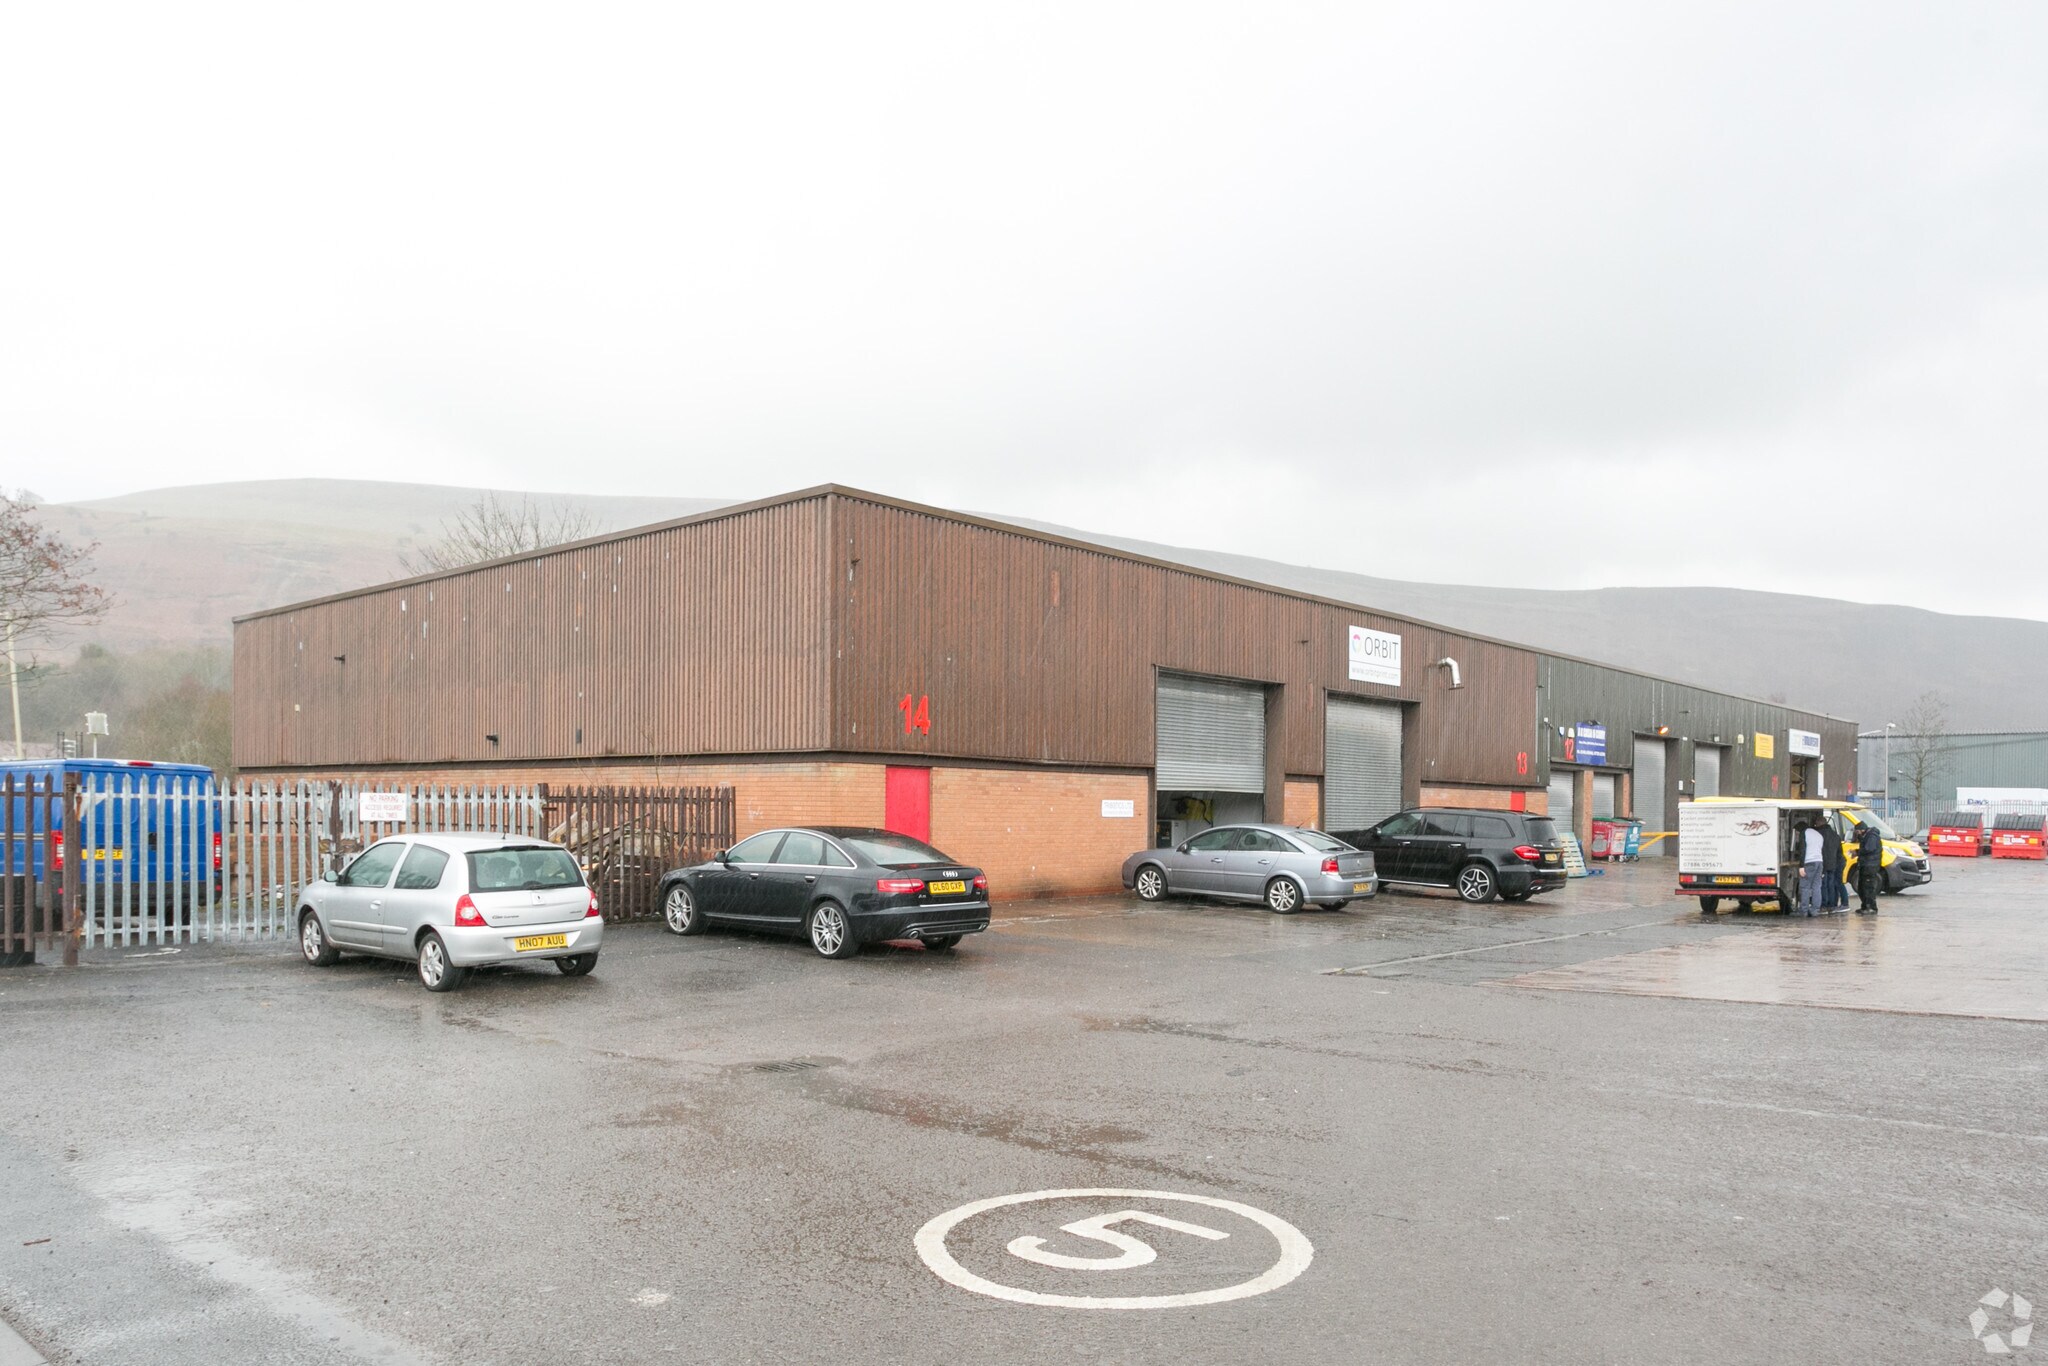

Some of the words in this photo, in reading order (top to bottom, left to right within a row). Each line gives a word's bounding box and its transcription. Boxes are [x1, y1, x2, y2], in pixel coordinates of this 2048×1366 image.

[1365, 636, 1399, 660] ORBIT
[899, 693, 931, 736] 14
[1564, 738, 1575, 760] 12
[1516, 751, 1528, 775] 13
[932, 883, 950, 891] GL60
[950, 882, 962, 890] GXP
[519, 937, 544, 948] HN07
[1006, 1209, 1230, 1271] 5
